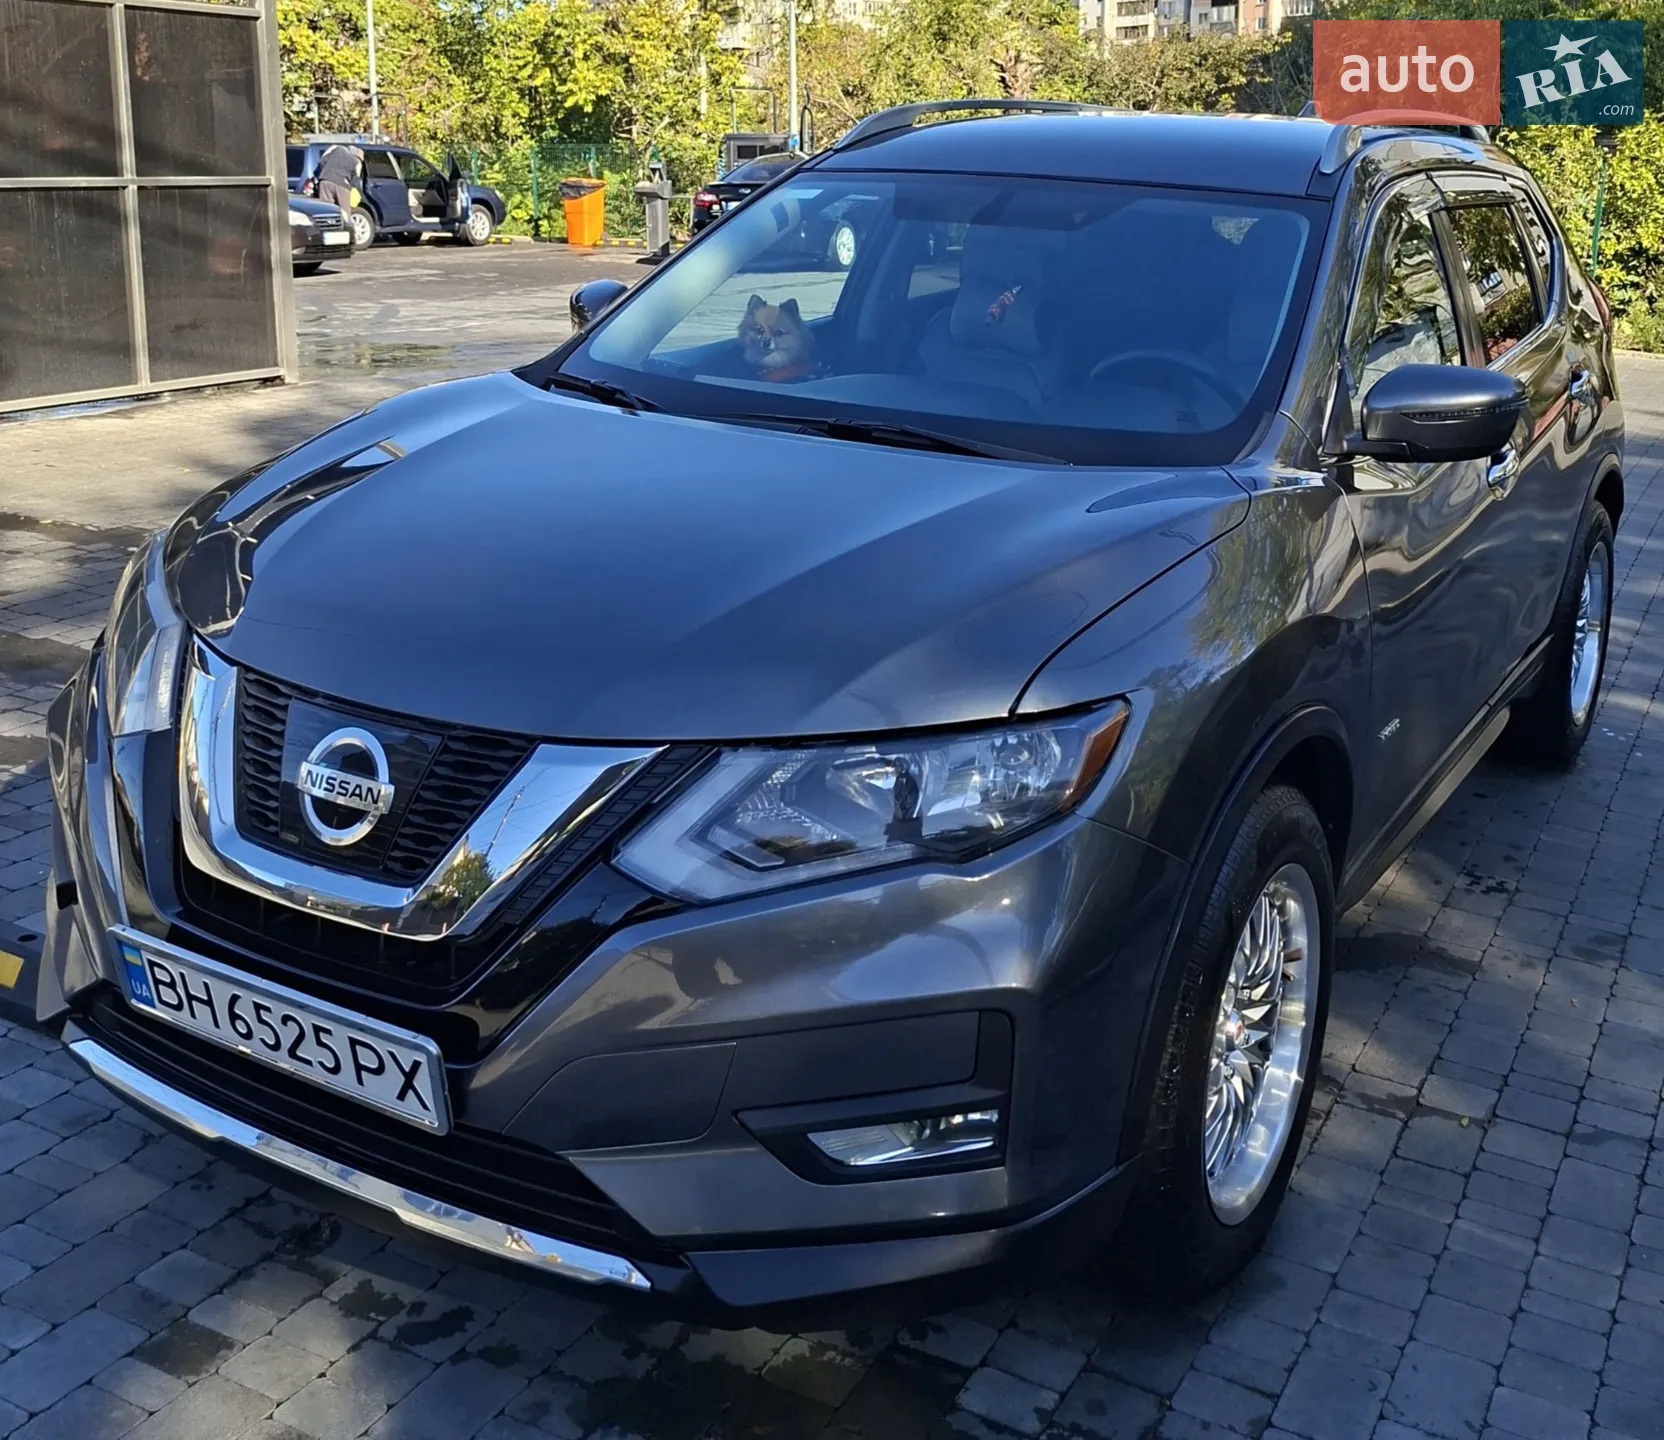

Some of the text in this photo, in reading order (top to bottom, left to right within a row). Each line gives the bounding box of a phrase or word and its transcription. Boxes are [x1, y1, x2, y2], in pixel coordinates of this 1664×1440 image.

[304, 769, 382, 805] NISSAN
[131, 978, 152, 999] UA
[227, 992, 342, 1075] 6525
